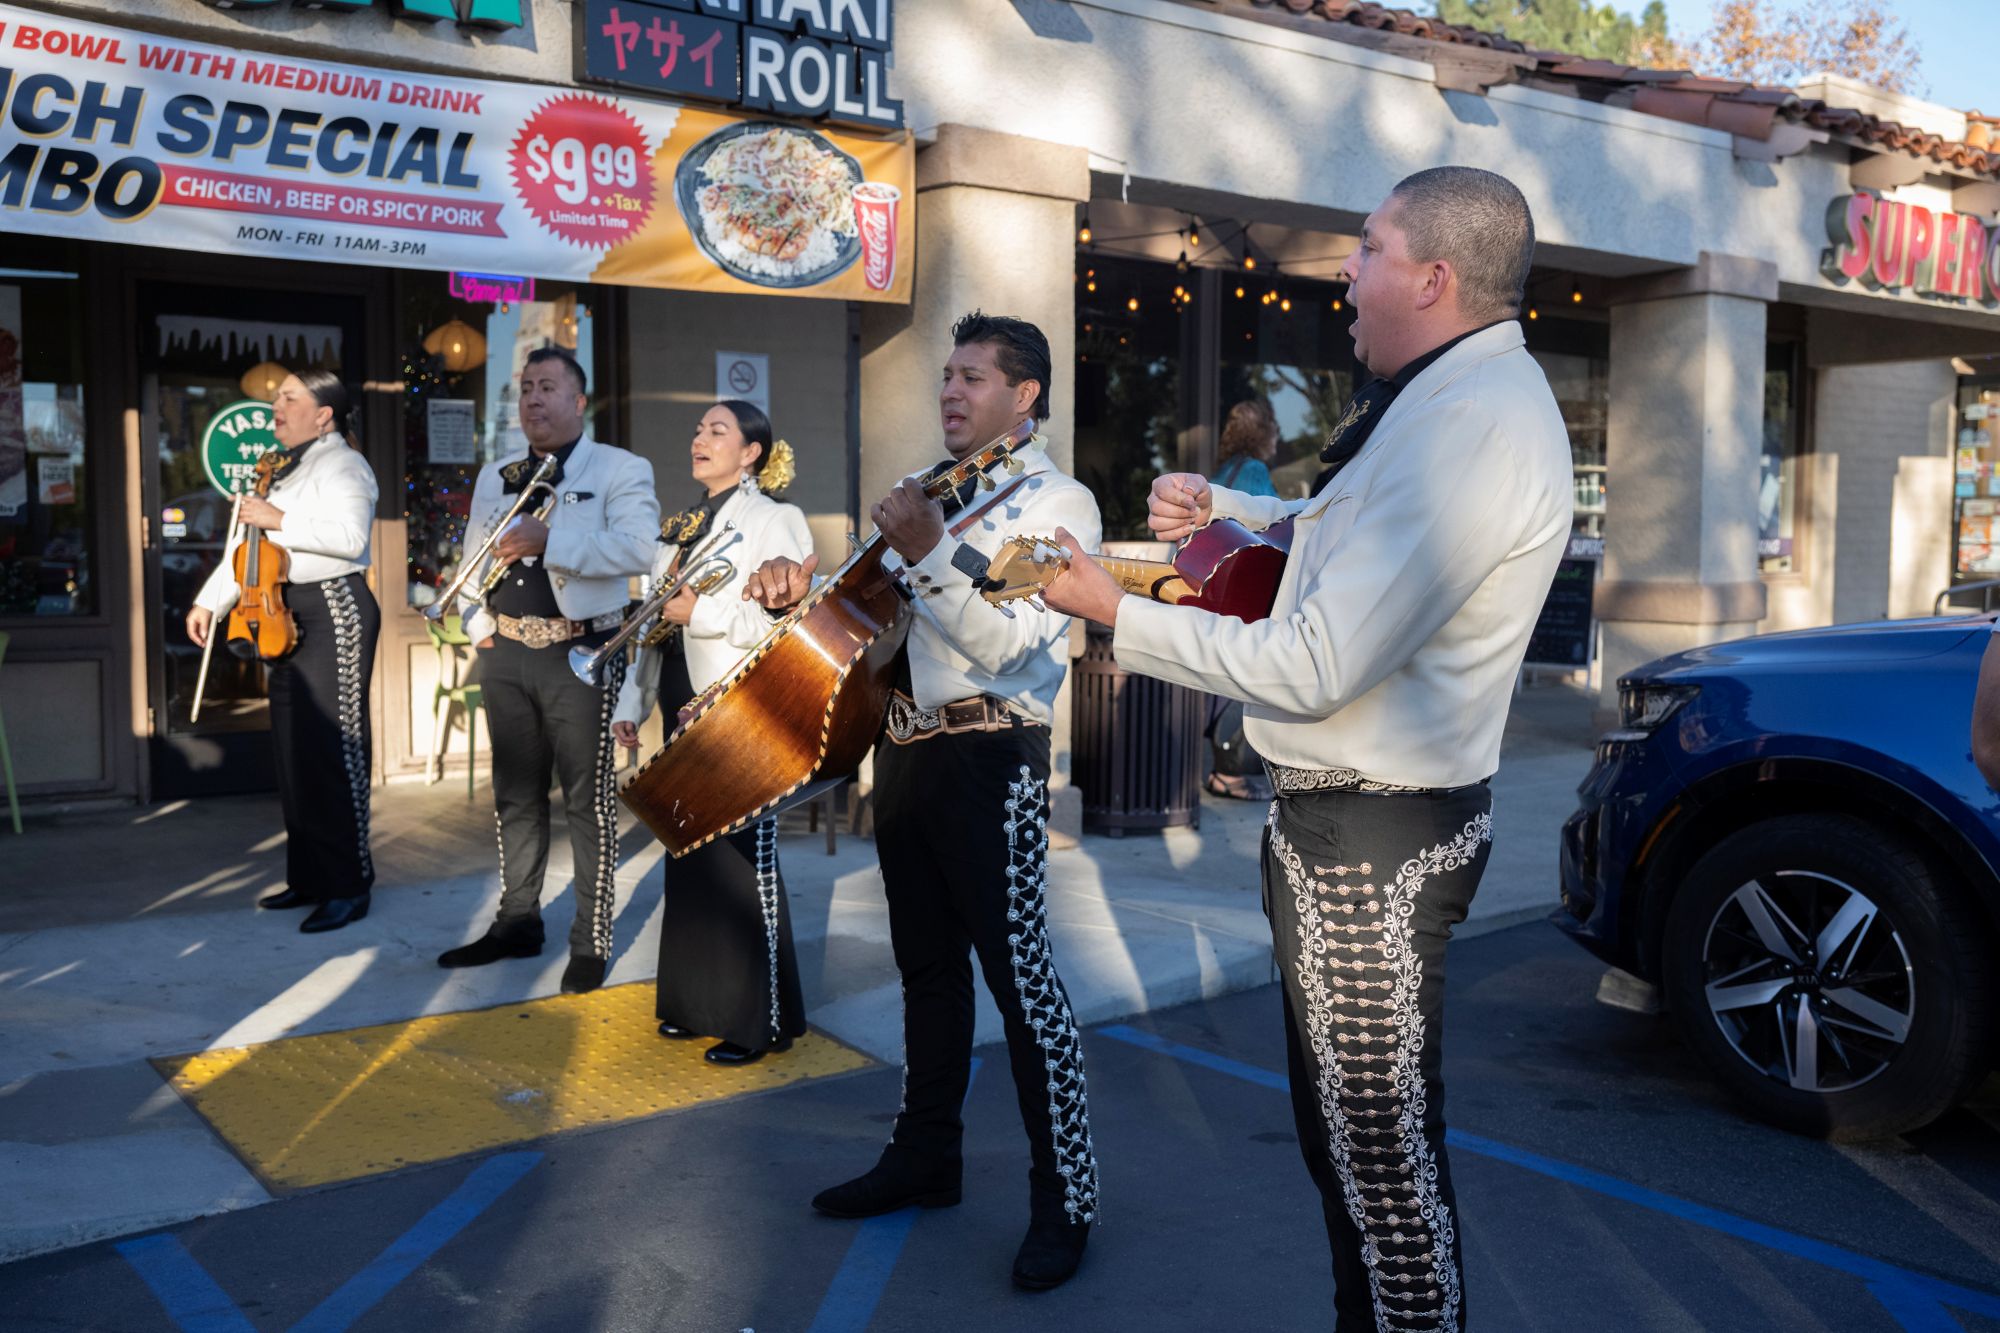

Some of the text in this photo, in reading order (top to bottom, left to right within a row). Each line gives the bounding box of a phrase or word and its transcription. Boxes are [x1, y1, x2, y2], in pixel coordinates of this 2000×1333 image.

[13, 25, 127, 64] BOWL
[139, 44, 236, 81] WITH
[242, 61, 381, 101] MEDIUM
[388, 82, 485, 115] DRINK
[602, 7, 723, 87] ヤサイ
[748, 36, 896, 121] ROLL
[0, 66, 481, 190] CH SPECIAL
[286, 190, 335, 212] BEEF
[339, 195, 369, 216] OR
[372, 199, 427, 222] SPICY
[431, 205, 485, 228] PORK
[549, 210, 629, 229] Limited Time
